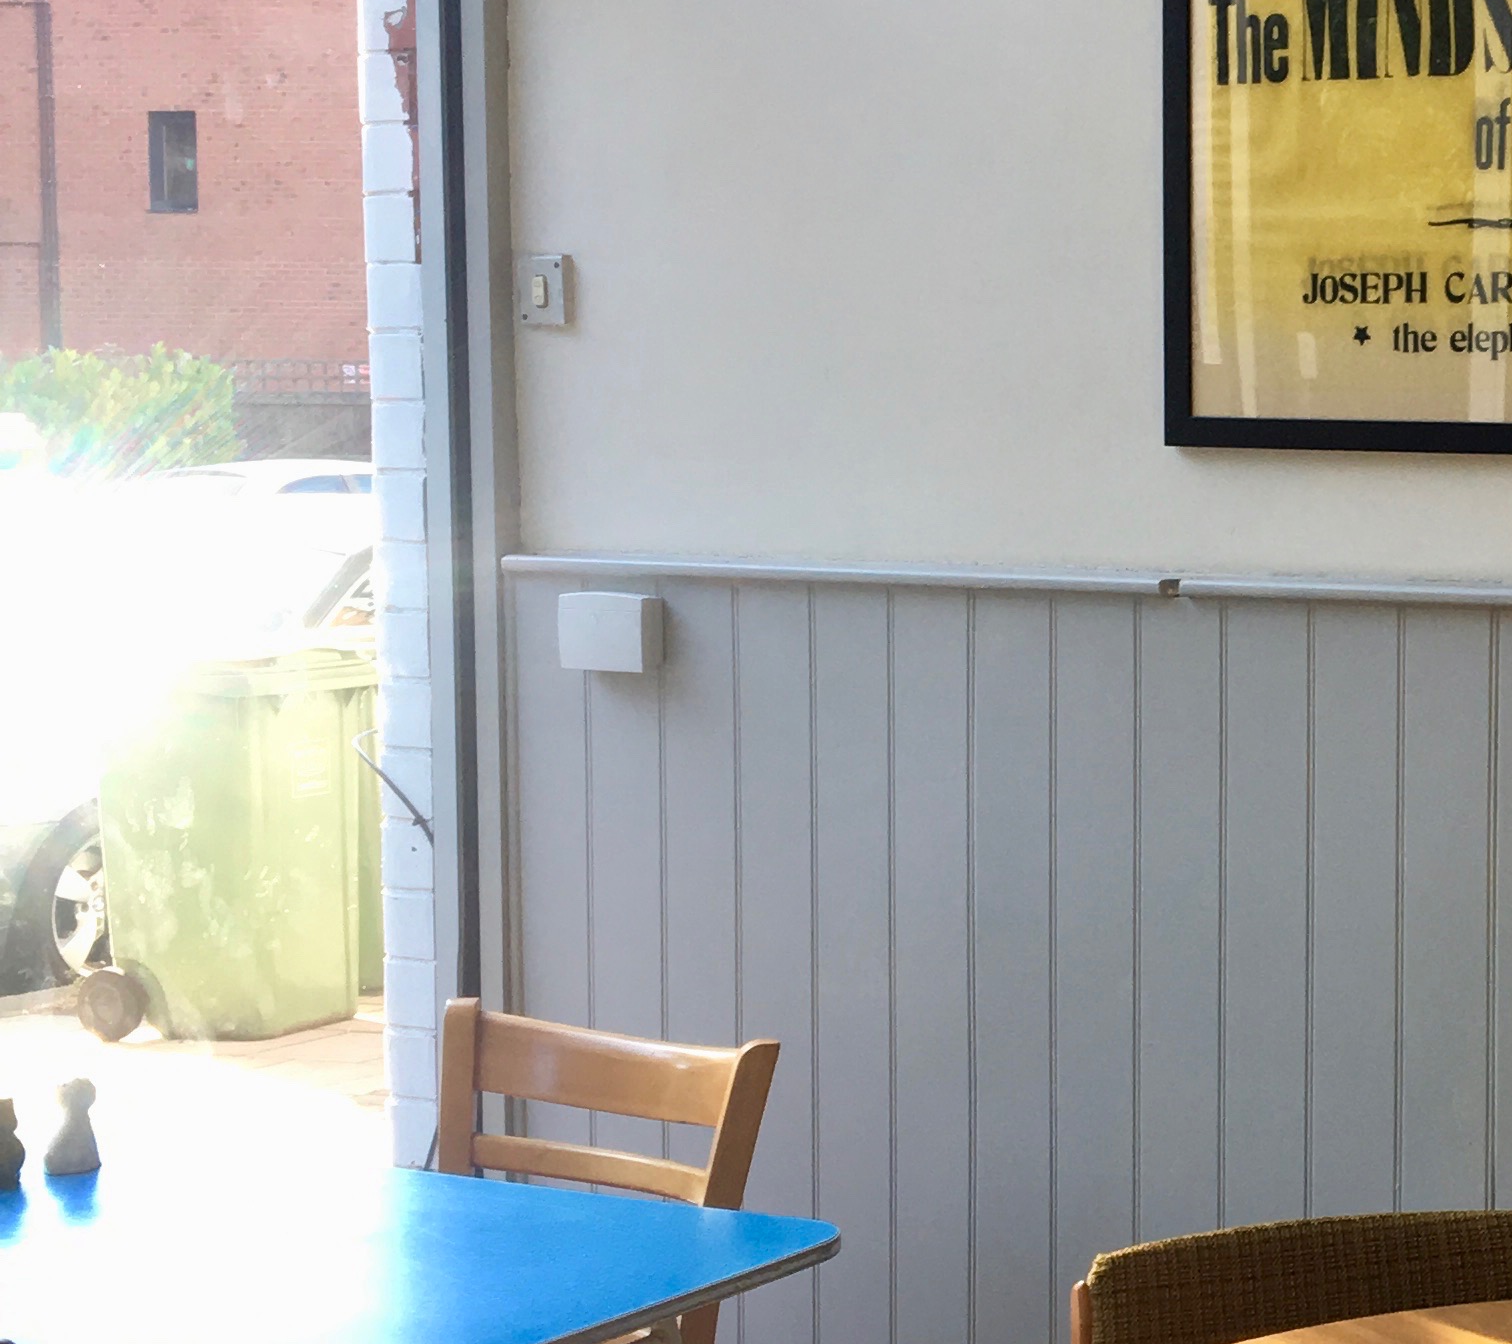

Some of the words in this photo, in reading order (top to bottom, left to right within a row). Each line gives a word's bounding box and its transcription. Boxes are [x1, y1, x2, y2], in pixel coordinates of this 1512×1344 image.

[1475, 99, 1510, 171] of
[1302, 272, 1428, 306] JOSEPH
[1392, 324, 1437, 353] the
